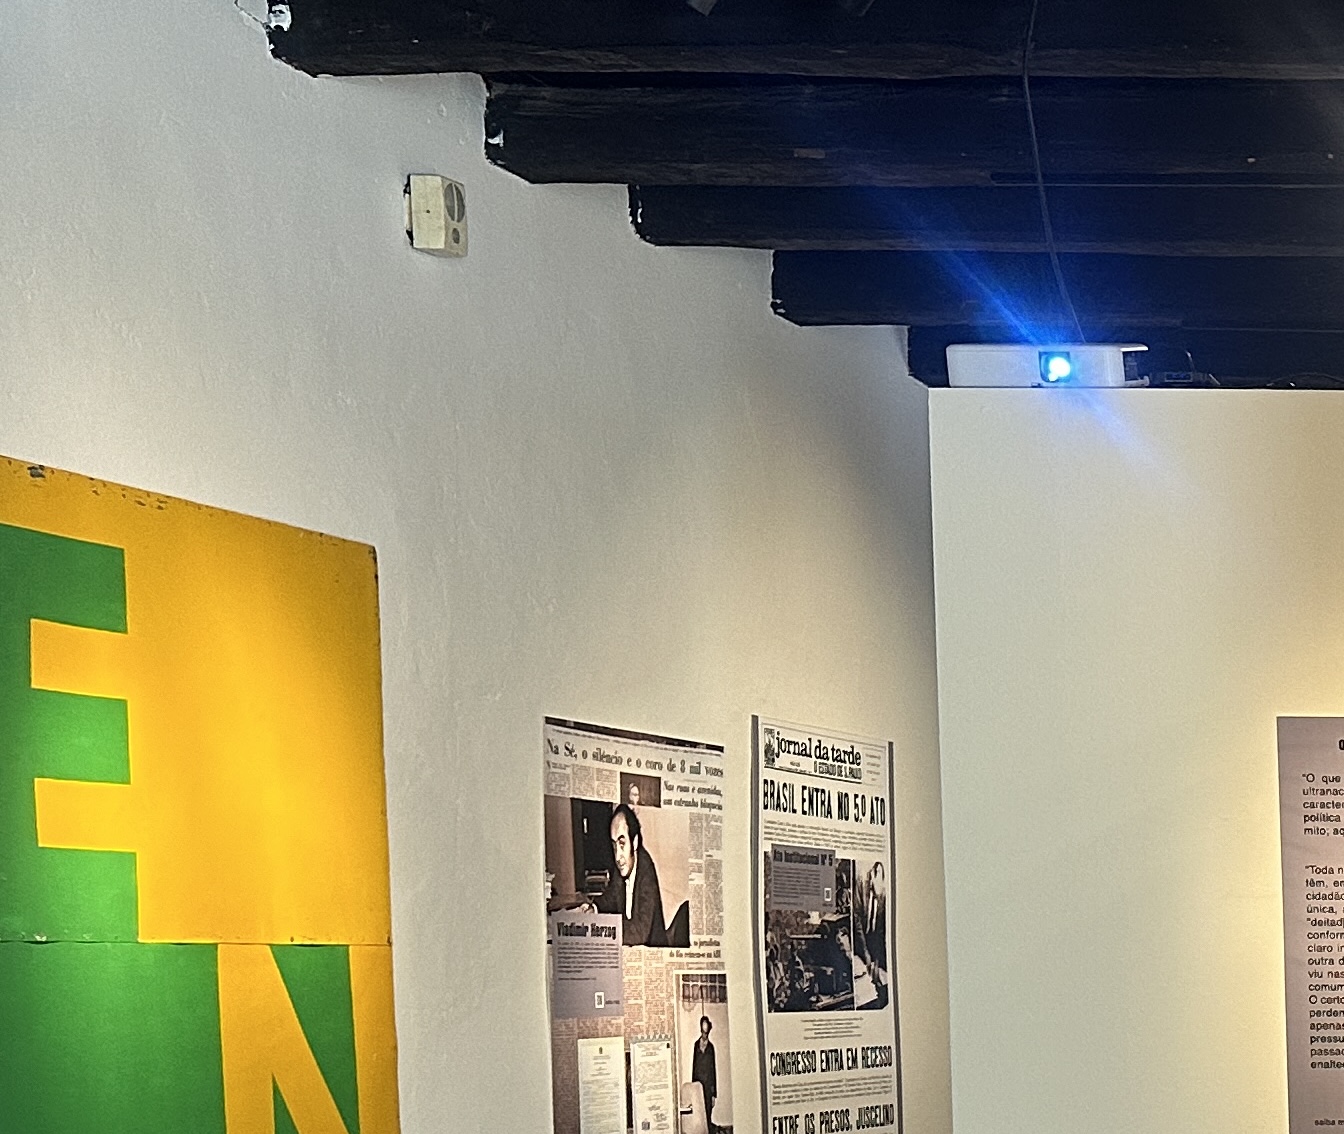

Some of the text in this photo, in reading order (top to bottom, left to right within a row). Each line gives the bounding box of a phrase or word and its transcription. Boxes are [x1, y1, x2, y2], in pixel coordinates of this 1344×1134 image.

[582, 750, 588, 759] o
[627, 757, 632, 767] e
[636, 758, 642, 768] o
[667, 758, 676, 772] de
[680, 759, 686, 773] 8
[776, 731, 861, 766] jornal da tarde
[1321, 776, 1342, 785] que
[763, 779, 797, 814] BRASIL
[801, 785, 832, 819] ENTRA
[837, 791, 849, 821] NO
[870, 796, 885, 826] ATO
[1303, 813, 1342, 825] política
[770, 1045, 892, 1076] CONGRESSO ENTRA EM RECESSO
[820, 1108, 853, 1134] PRESOS,
[856, 1104, 895, 1130] JUSCELINO
